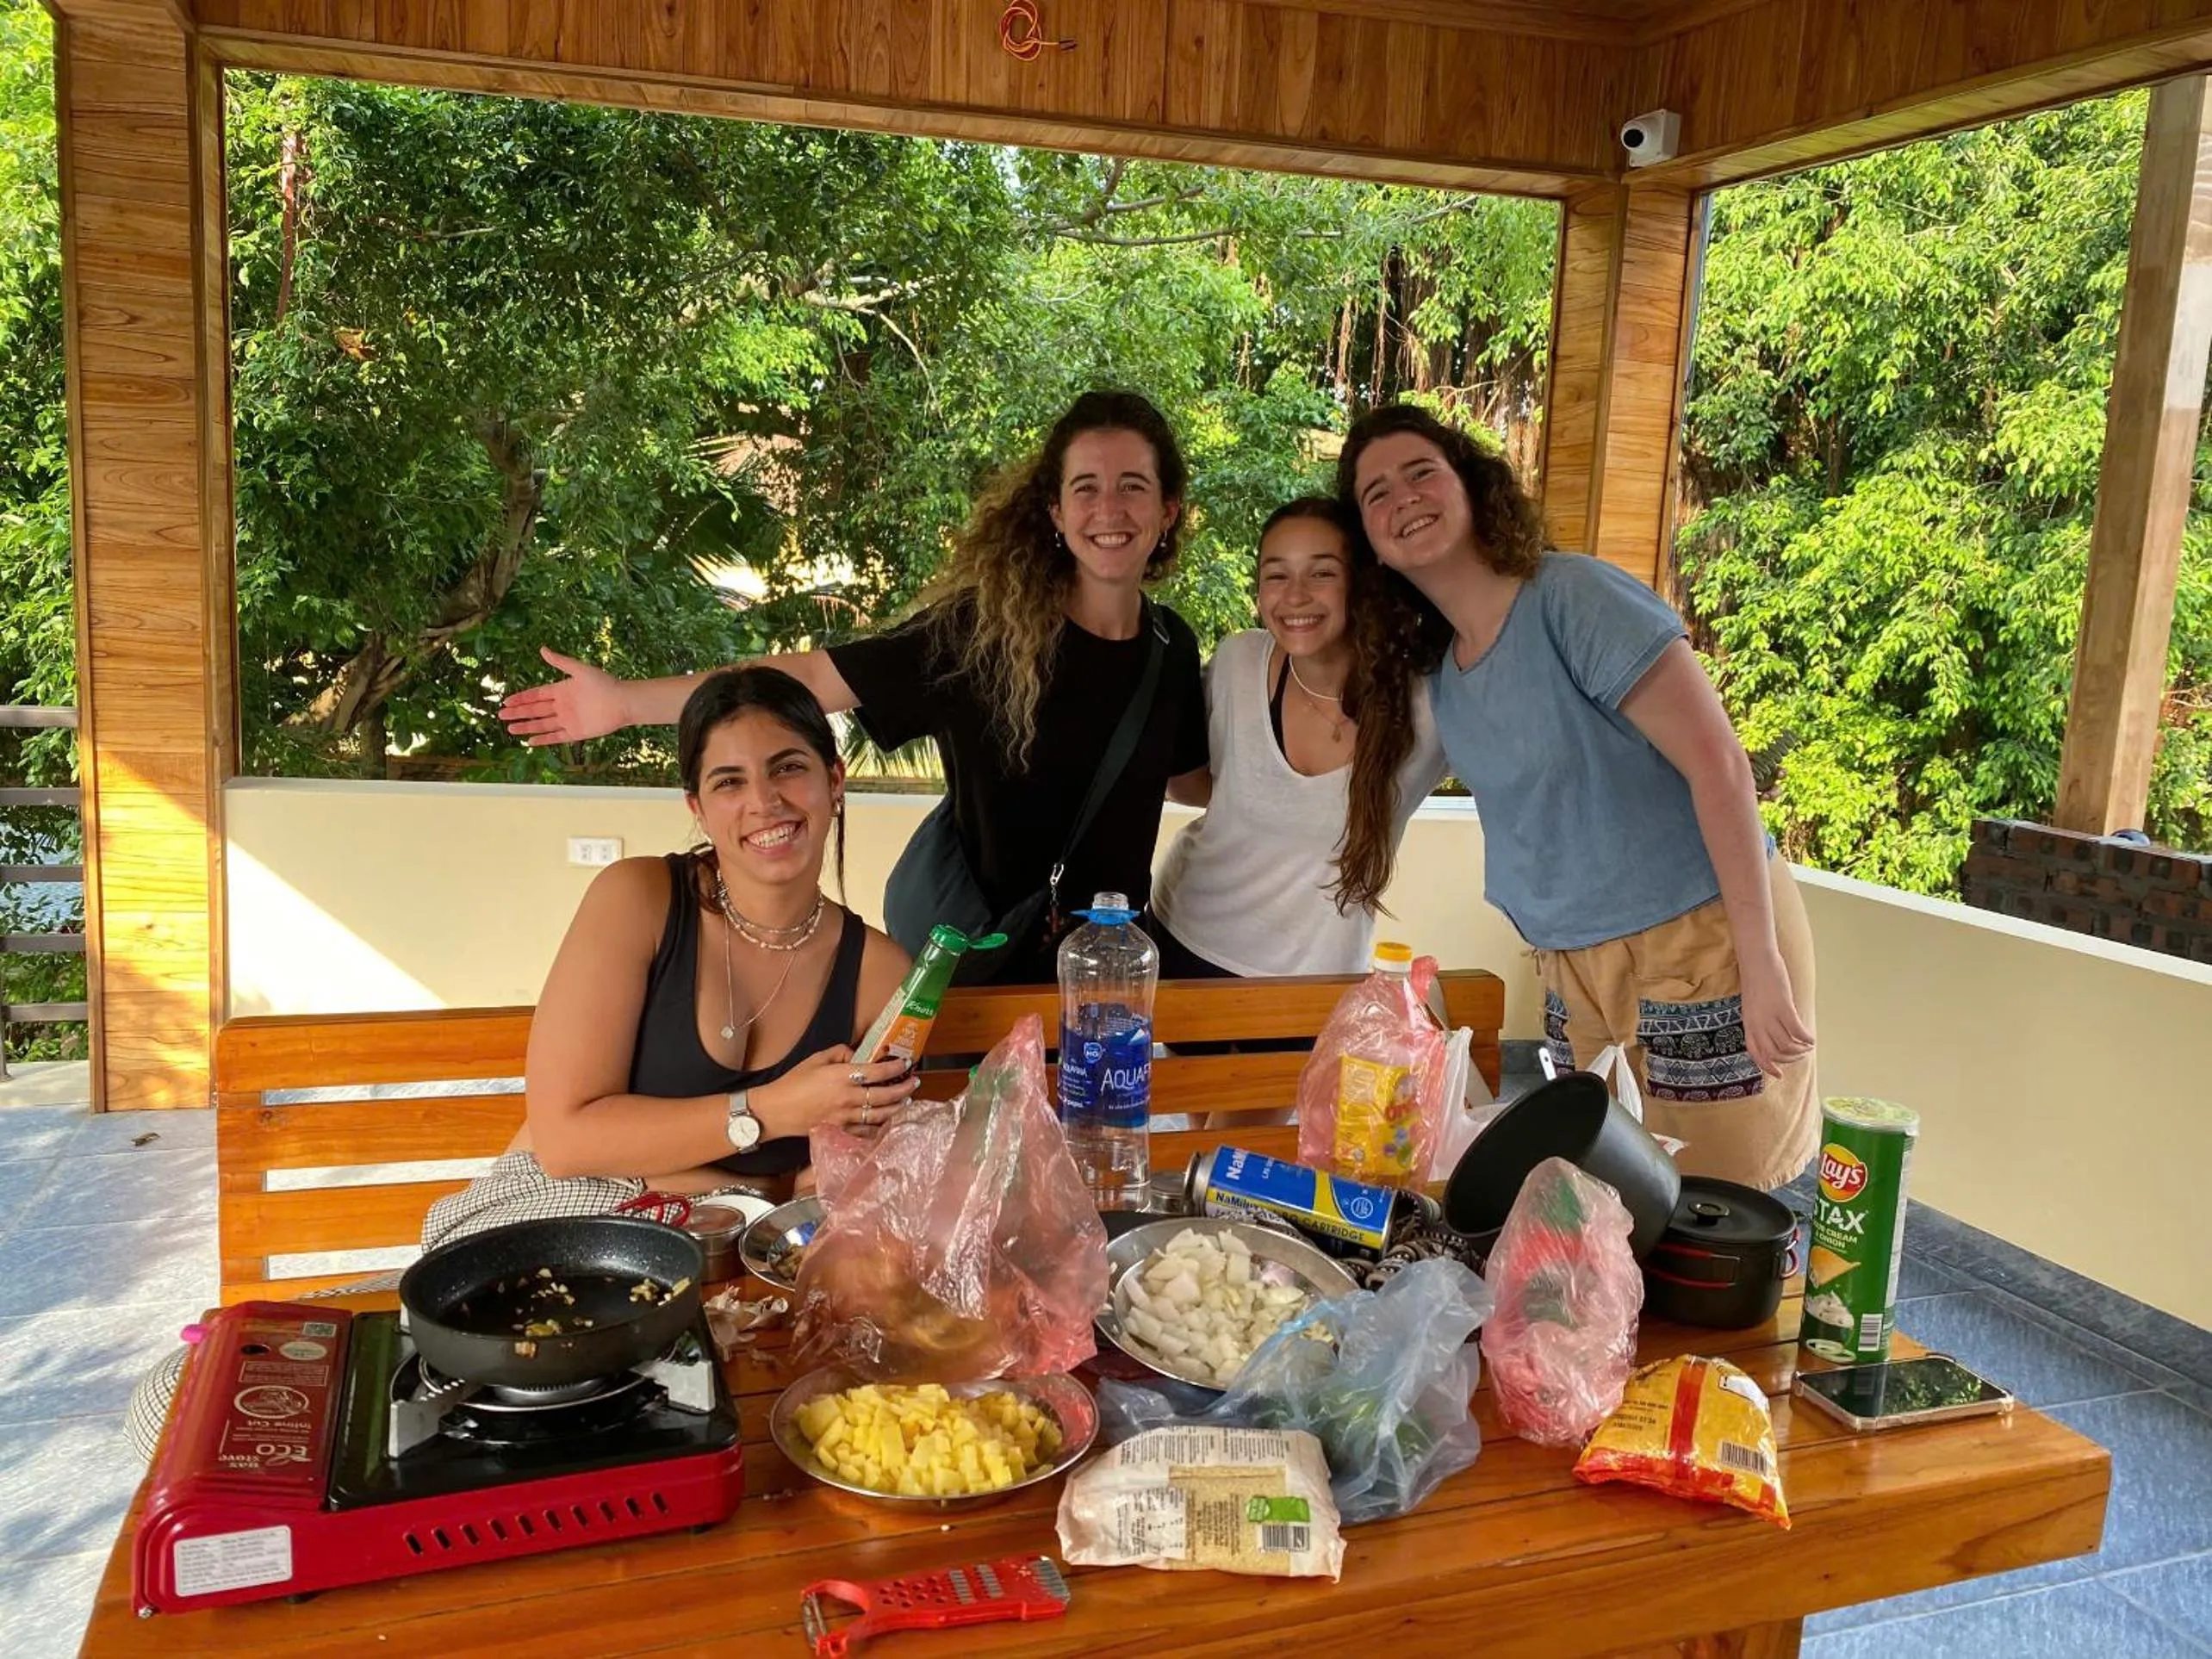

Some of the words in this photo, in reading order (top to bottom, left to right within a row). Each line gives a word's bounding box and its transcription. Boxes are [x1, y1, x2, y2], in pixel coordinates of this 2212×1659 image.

[1821, 1153, 1864, 1190] Lay's
[1826, 1227, 1858, 1244] CREAM
[256, 1444, 308, 1457] ECO
